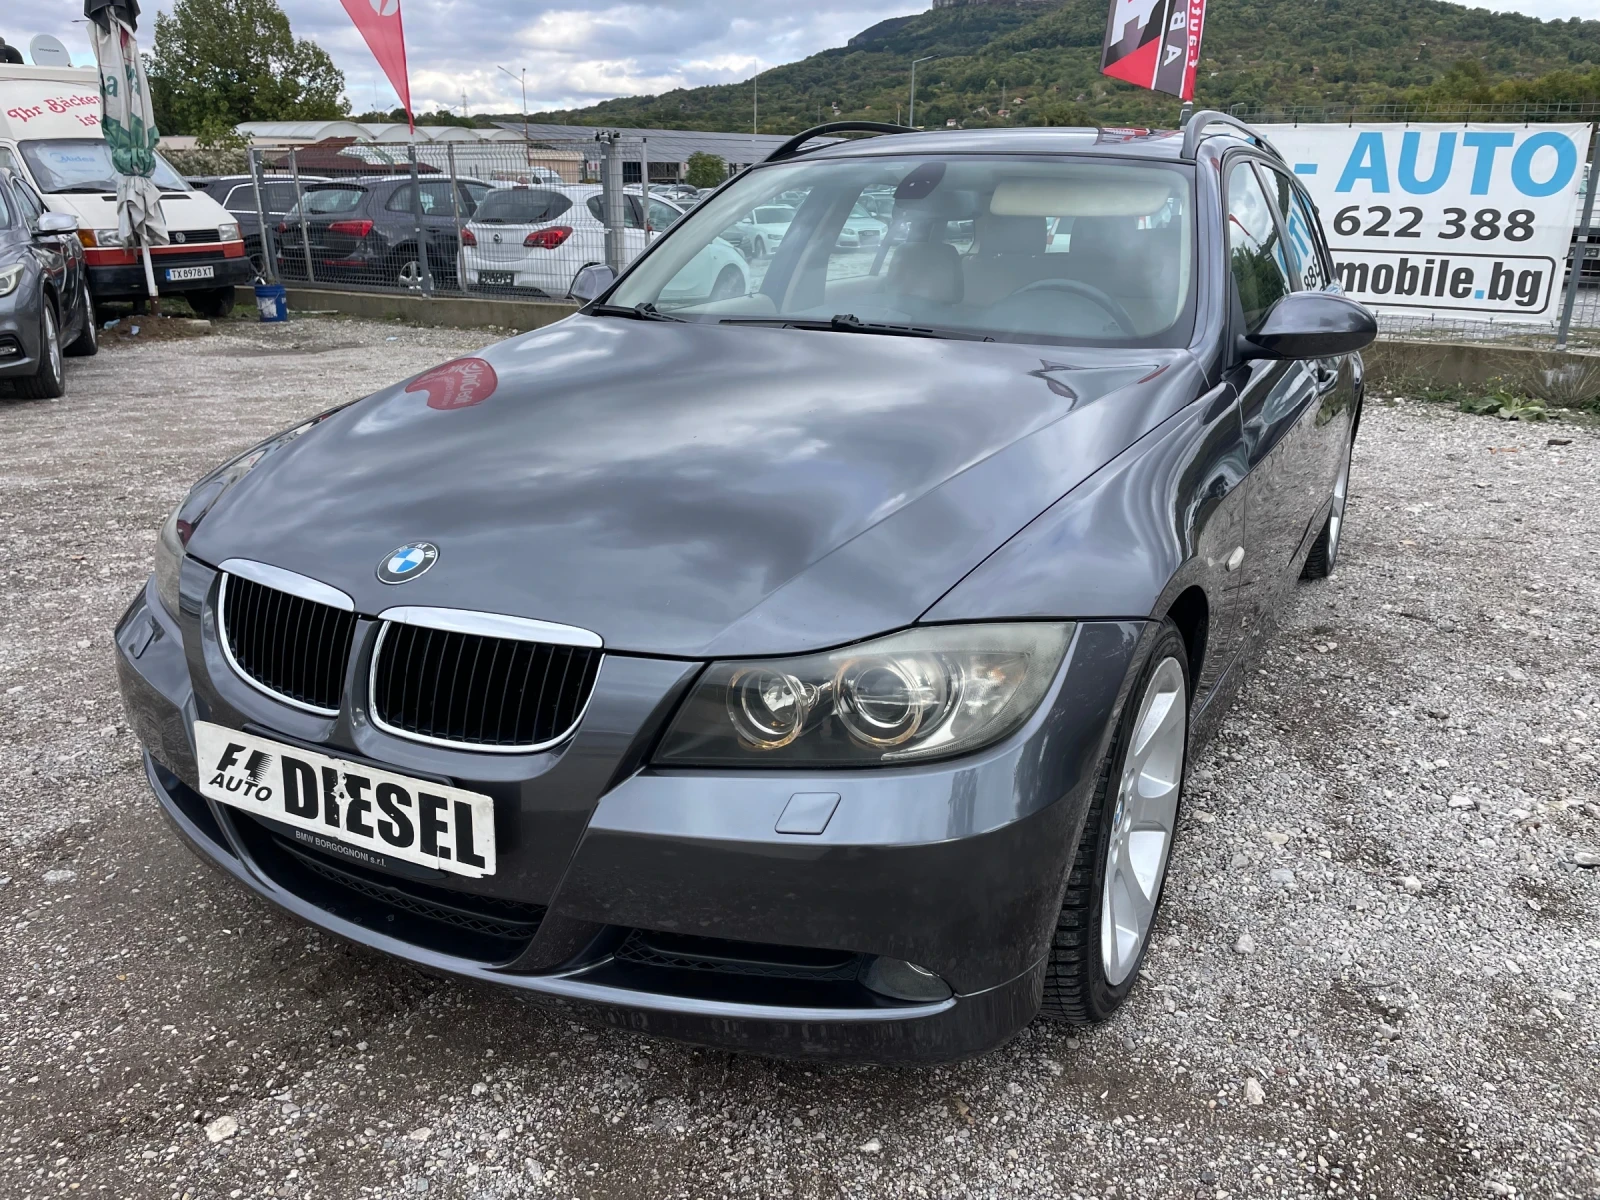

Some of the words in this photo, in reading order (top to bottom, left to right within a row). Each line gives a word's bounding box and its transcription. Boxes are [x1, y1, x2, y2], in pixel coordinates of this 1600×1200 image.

[1334, 131, 1577, 198] AUTO
[1333, 205, 1424, 238] 622
[1437, 207, 1535, 242] 388
[1336, 258, 1543, 307] mobile.bg
[209, 772, 273, 802] AUTO
[281, 755, 486, 869] DIESEL
[295, 830, 314, 843] BMW
[315, 837, 369, 862] BORGOGNONI
